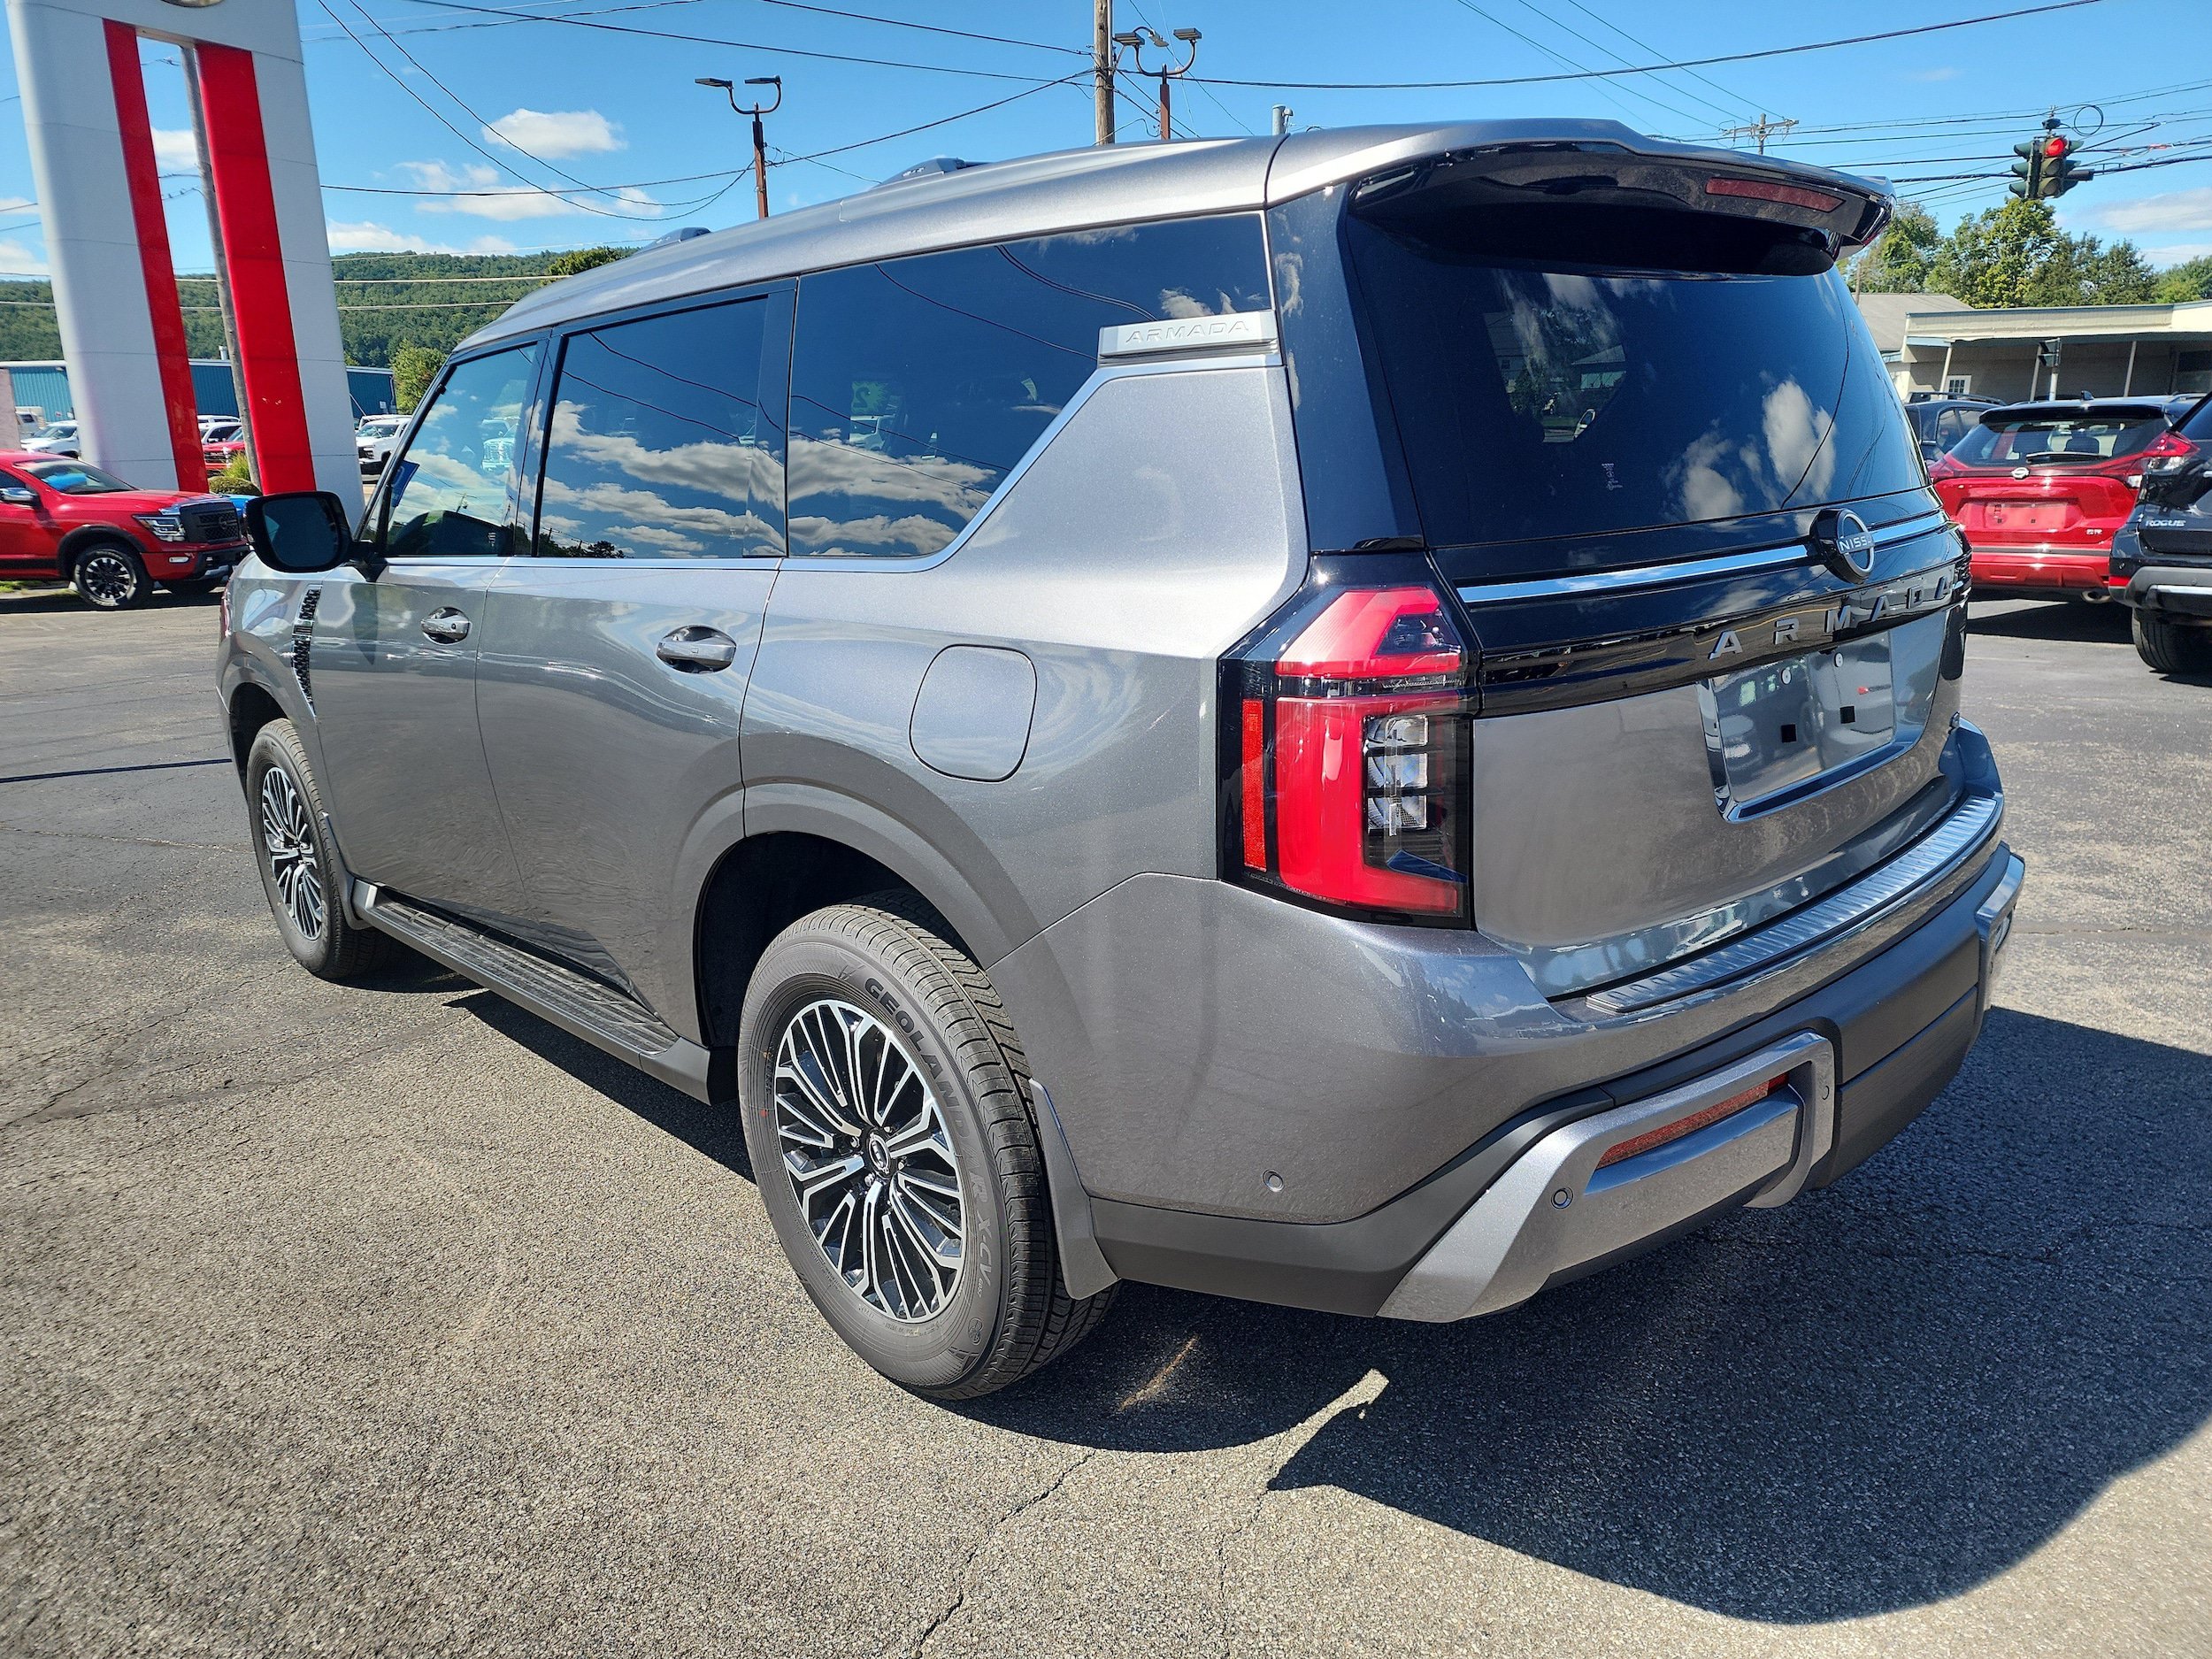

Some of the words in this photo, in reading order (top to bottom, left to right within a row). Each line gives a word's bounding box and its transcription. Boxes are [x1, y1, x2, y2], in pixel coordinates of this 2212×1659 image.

[1125, 320, 1249, 344] ARMADA
[1839, 535, 1872, 551] NISS
[1708, 575, 1952, 661] ARMADA
